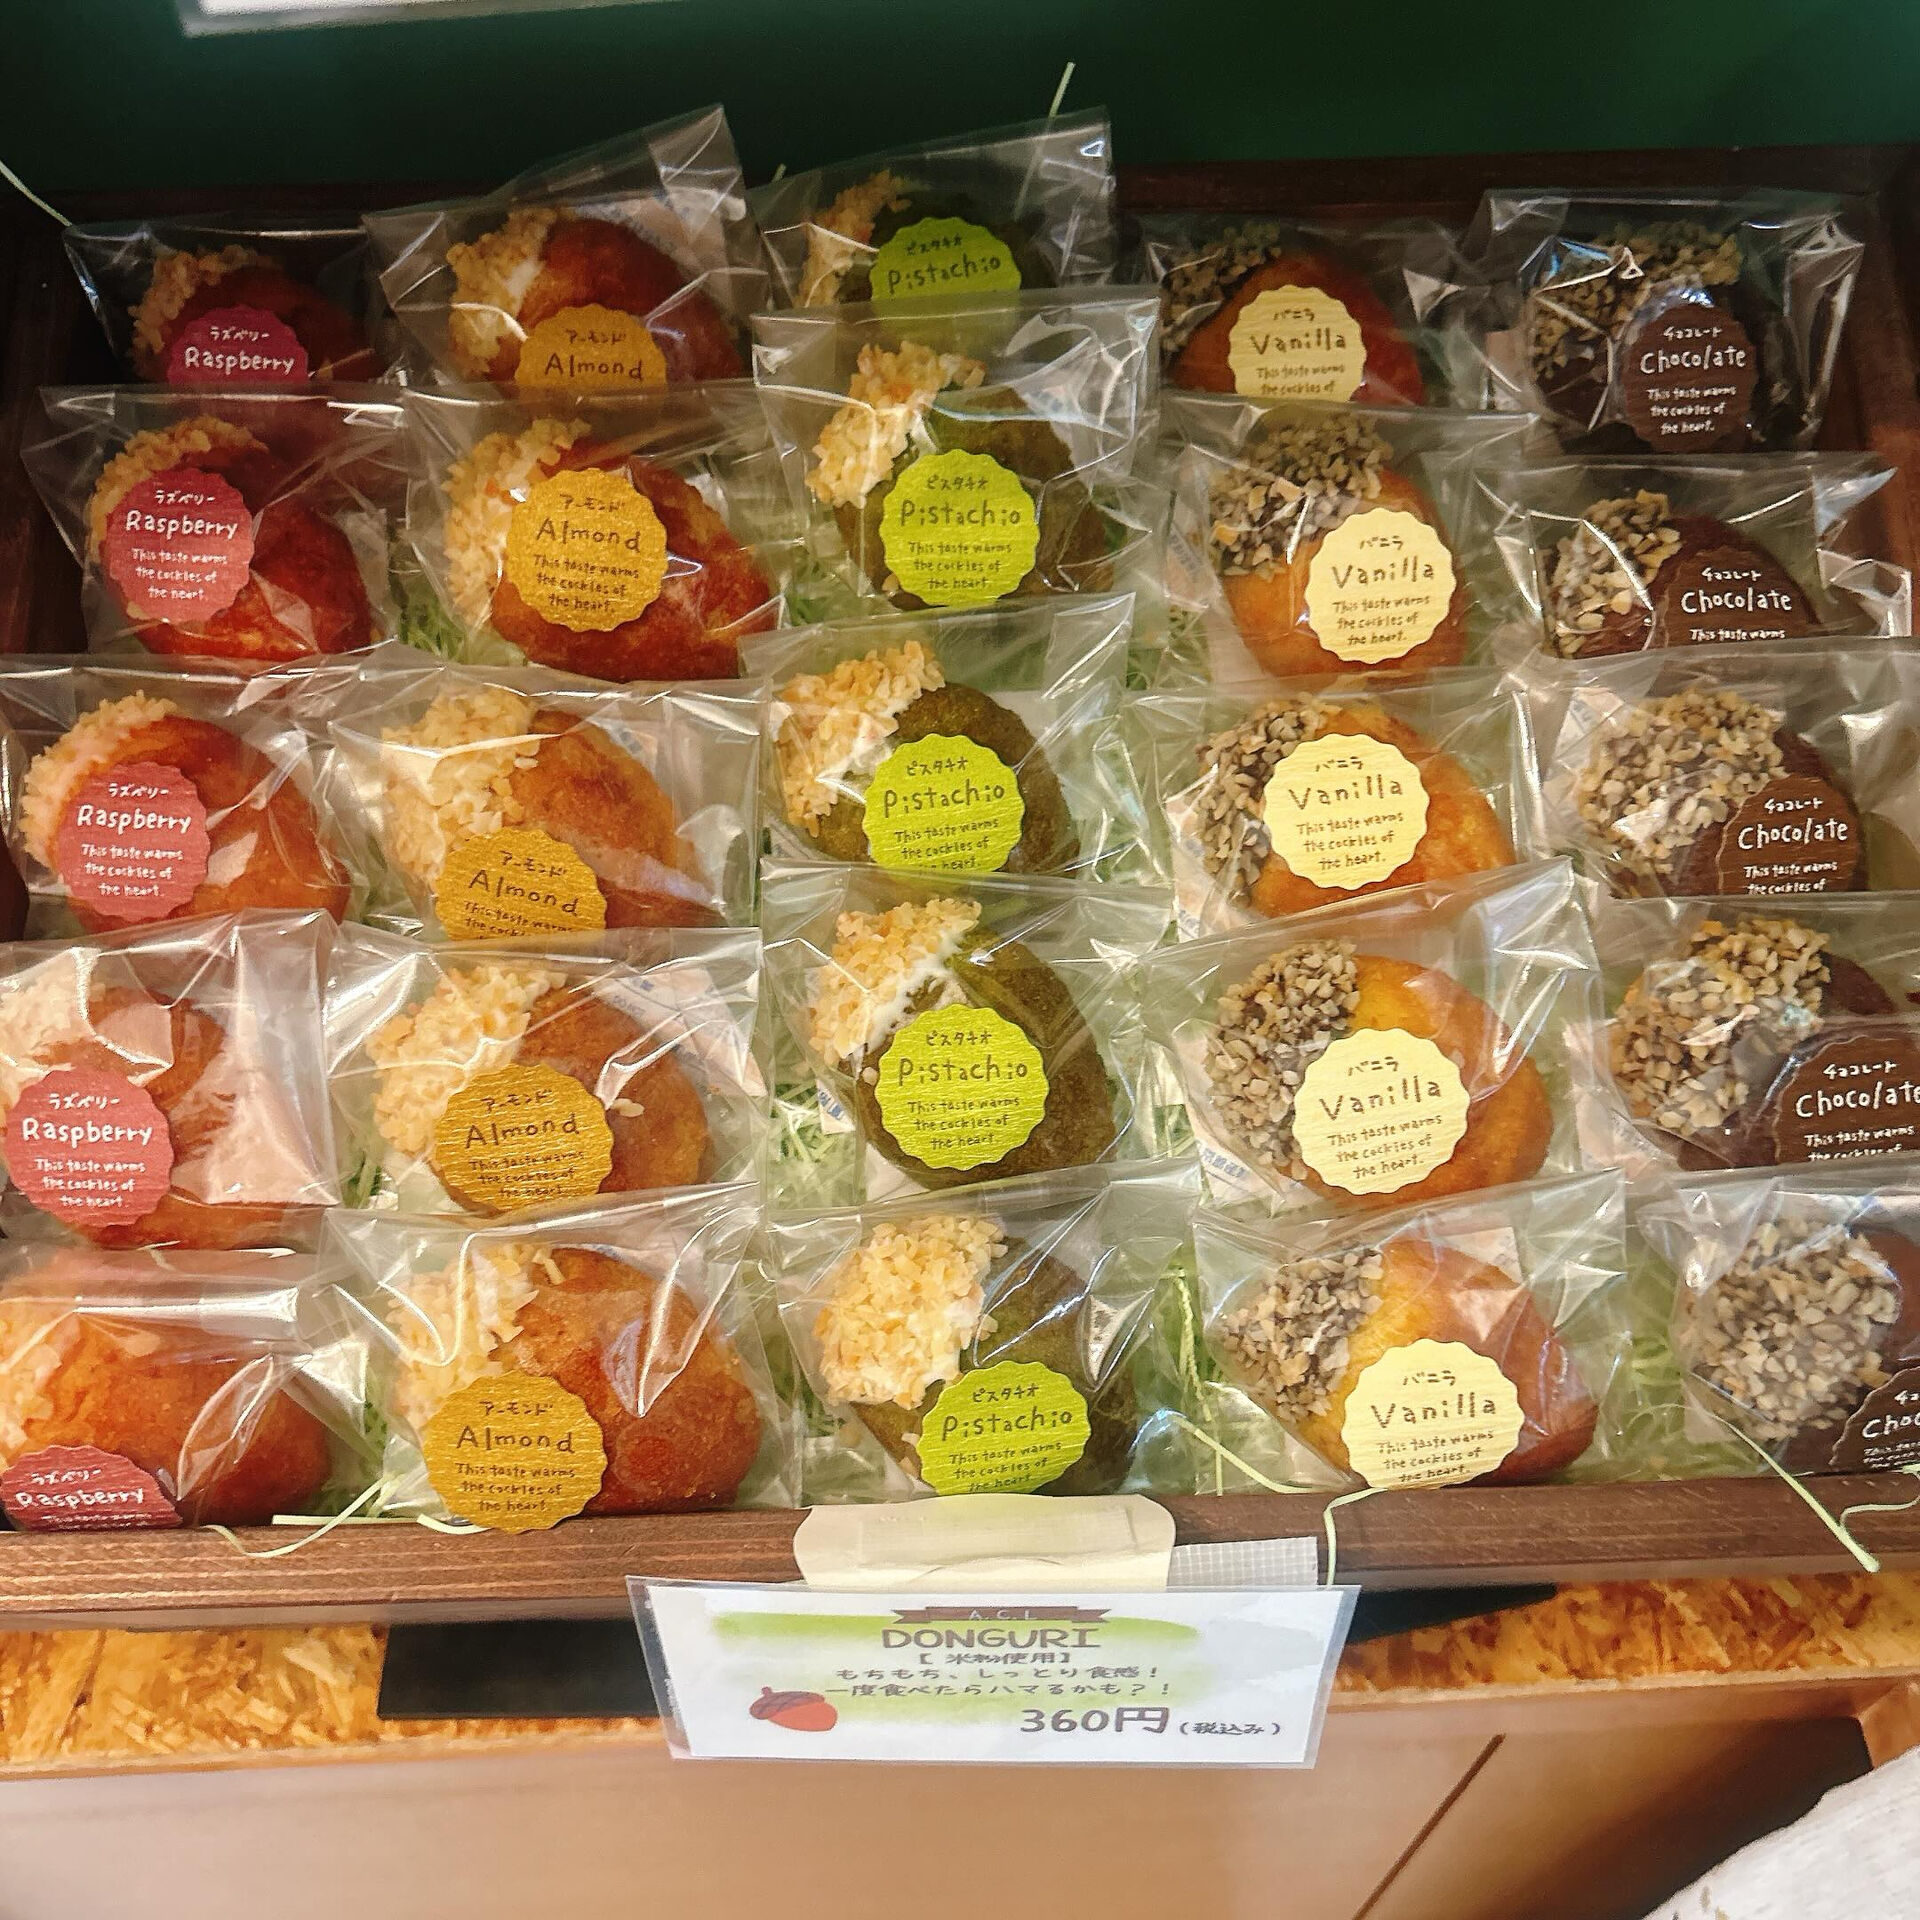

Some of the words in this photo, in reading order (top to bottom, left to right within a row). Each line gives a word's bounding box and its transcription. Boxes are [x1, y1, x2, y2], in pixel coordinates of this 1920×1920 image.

[887, 252, 1001, 296] Pistachio
[1249, 327, 1347, 356] Vanilla
[185, 344, 295, 375] Raspberry
[545, 352, 645, 380] Almond
[1640, 344, 1746, 374] Chocolate
[901, 499, 1021, 526] Pistachio
[125, 509, 238, 539] Raspberry
[537, 517, 641, 553] Almond
[909, 542, 934, 554] This
[937, 543, 970, 554] taste
[973, 544, 1012, 554] warms
[1360, 535, 1404, 550] バニラ
[533, 554, 559, 568] This
[564, 559, 595, 574] taste
[599, 564, 639, 579] warms
[914, 561, 933, 571] the
[988, 560, 1002, 573] of
[1331, 555, 1434, 589] Vanilla
[537, 573, 556, 585] the
[612, 583, 627, 597] of
[549, 593, 569, 606] the
[1332, 600, 1358, 613] This
[1361, 598, 1392, 612] taste
[1394, 596, 1430, 607] warms
[1680, 586, 1792, 614] Chocolate
[1337, 618, 1356, 630] the
[1407, 612, 1419, 625] of
[1348, 634, 1367, 646] the
[1690, 628, 1716, 641] This
[1718, 628, 1748, 641] taste
[1749, 629, 1786, 640] warms
[907, 756, 967, 775] ピスタチオ
[1315, 756, 1363, 772] バニラ
[885, 779, 1005, 819] Pistachio
[1288, 774, 1402, 810] Vanilla
[77, 804, 193, 835] Raspberry
[895, 829, 920, 841] This
[924, 825, 957, 837] taste
[959, 818, 999, 832] warms
[1297, 824, 1325, 836] This
[1327, 818, 1360, 833] taste
[1363, 812, 1404, 826] warms
[1303, 842, 1324, 853] the
[1381, 830, 1394, 844] of
[1738, 818, 1848, 850] Chocolate
[82, 843, 107, 858] This
[110, 845, 141, 859] taste
[144, 849, 184, 861] warms
[901, 848, 922, 859] the
[976, 836, 989, 849] of
[85, 862, 105, 876] the
[159, 866, 173, 880] of
[1319, 859, 1341, 871] the
[1744, 866, 1769, 879] This
[1771, 864, 1800, 878] taste
[1803, 861, 1838, 874] warms
[468, 869, 576, 917] Almond
[1747, 884, 1766, 895] the
[1814, 878, 1826, 892] of
[926, 1031, 992, 1046] ピスタチオ
[899, 1054, 1028, 1086] Pistachio
[1348, 1056, 1395, 1076] バニラ
[1823, 1060, 1899, 1080] チョコレート
[908, 1101, 936, 1114] This
[940, 1099, 975, 1112] taste
[980, 1097, 1020, 1109] warms
[1319, 1075, 1441, 1120] Vanilla
[1795, 1081, 1920, 1117] Chocolate
[22, 1117, 153, 1149] Raspberry
[465, 1112, 579, 1148] Almond
[914, 1120, 937, 1131] the
[996, 1115, 1010, 1126] of
[1327, 1134, 1356, 1146] This
[1360, 1125, 1395, 1140] taste
[1399, 1115, 1442, 1131] warms
[1336, 1151, 1359, 1162] the
[1418, 1134, 1432, 1147] of
[1804, 1134, 1833, 1148] This
[1836, 1129, 1870, 1144] taste
[1873, 1126, 1914, 1139] warms
[35, 1158, 64, 1172] This
[67, 1160, 101, 1172] taste
[102, 1162, 146, 1172] warms
[1353, 1165, 1377, 1178] the
[41, 1176, 65, 1190] the
[121, 1179, 136, 1192] of
[1402, 1370, 1456, 1386] バニラ
[973, 1383, 1039, 1402] ピスタチオ
[479, 1401, 554, 1416] アーモンド
[1371, 1391, 1497, 1428] Vanilla
[941, 1406, 1073, 1441] Pistachio
[456, 1426, 575, 1454] Almond
[1378, 1441, 1408, 1454] This
[1410, 1436, 1447, 1451] taste
[1450, 1431, 1494, 1444] warms
[949, 1453, 978, 1465] This
[981, 1448, 1017, 1460] taste
[1020, 1442, 1062, 1455] warms
[1383, 1459, 1406, 1469] the
[1467, 1447, 1482, 1459] of
[455, 1463, 485, 1476] This
[489, 1465, 526, 1477] taste
[532, 1466, 575, 1478] warms
[954, 1468, 977, 1479] the
[1035, 1457, 1047, 1467] of
[1398, 1473, 1422, 1482] the
[16, 1488, 143, 1509] Raspberry
[461, 1481, 484, 1494] the
[548, 1484, 563, 1495] of
[881, 1627, 1101, 1649] DONGURI
[1020, 1707, 1169, 1734] 360円
